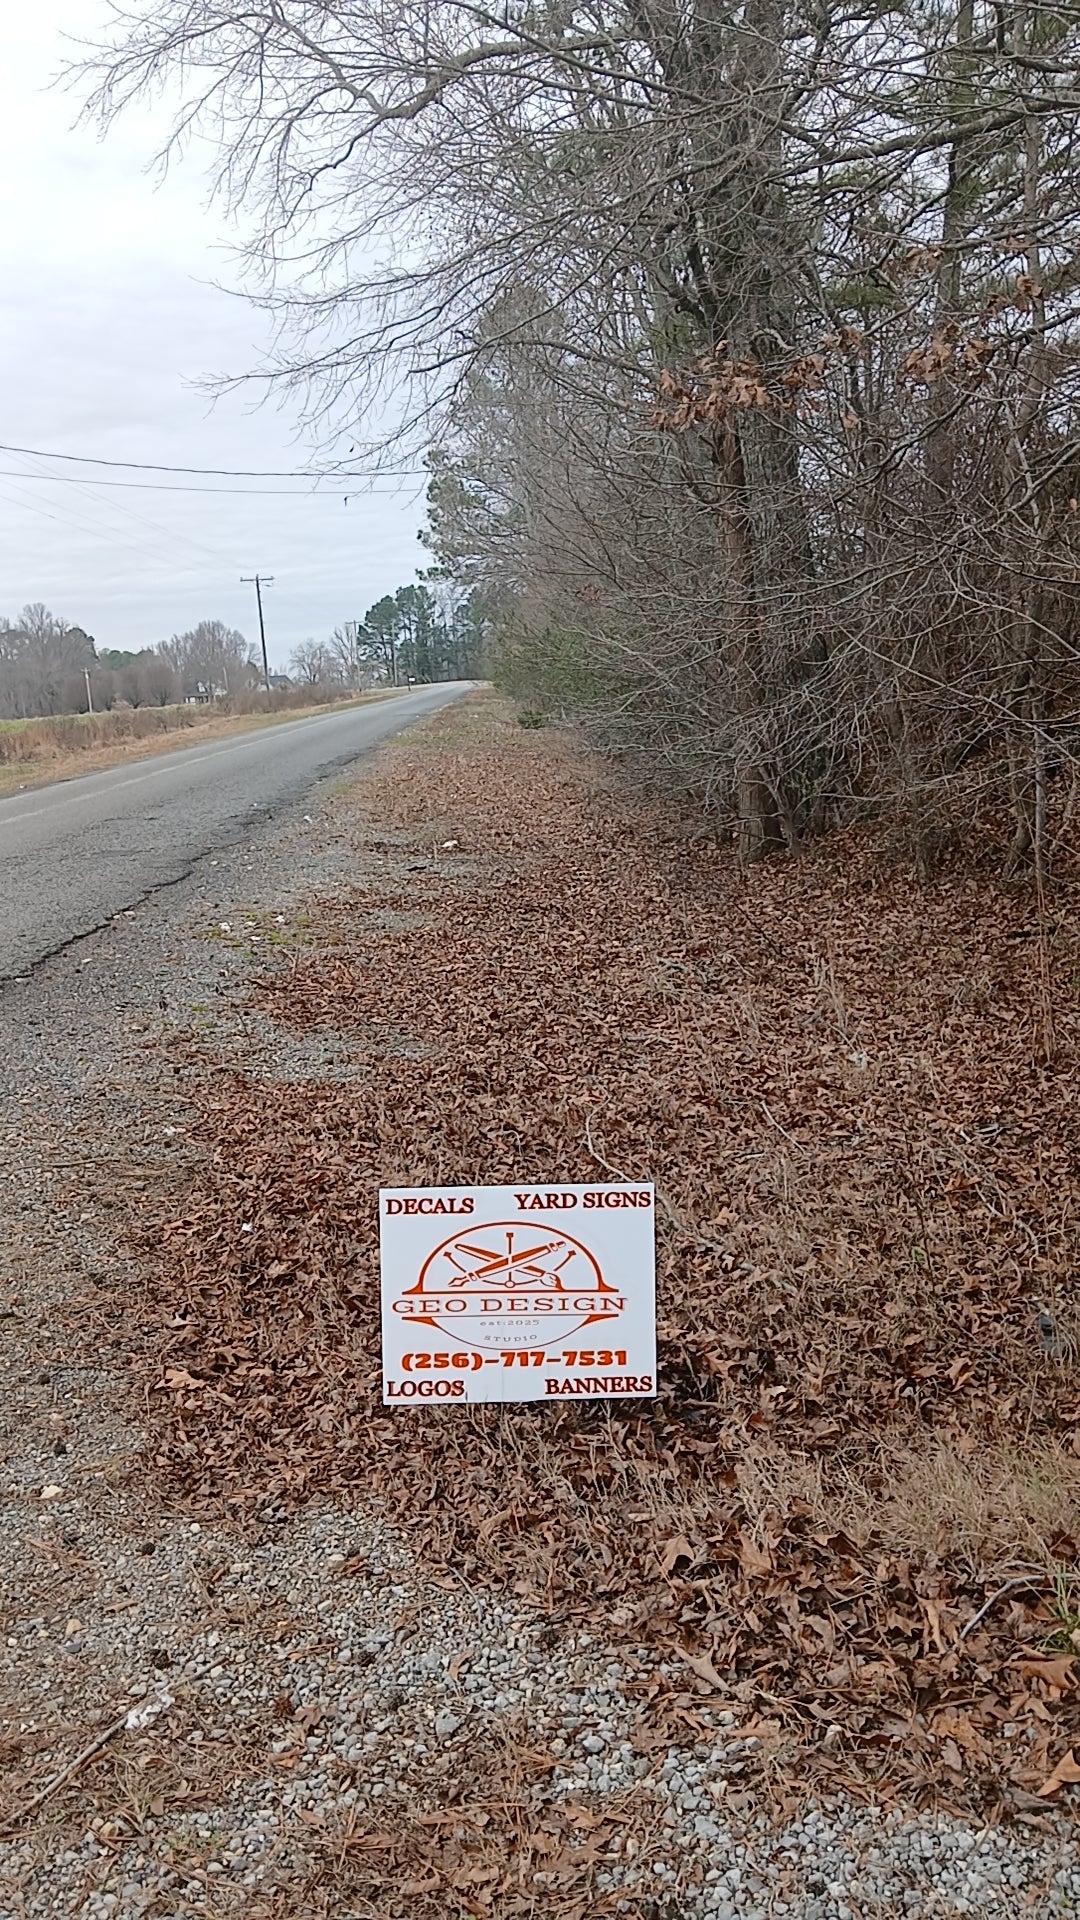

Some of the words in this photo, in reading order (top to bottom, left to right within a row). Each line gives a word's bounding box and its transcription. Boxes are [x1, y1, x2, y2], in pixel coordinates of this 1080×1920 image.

[385, 1198, 474, 1214] DECALS
[514, 1193, 577, 1210] YARD
[583, 1192, 651, 1208] SIGNS
[392, 1299, 467, 1313] GEO
[480, 1298, 627, 1311] DESIGN
[483, 1334, 538, 1342] STUDIO
[401, 1351, 627, 1371] (256)-717-7531
[387, 1381, 464, 1396] LOGOS
[545, 1376, 652, 1394] BANNERS
